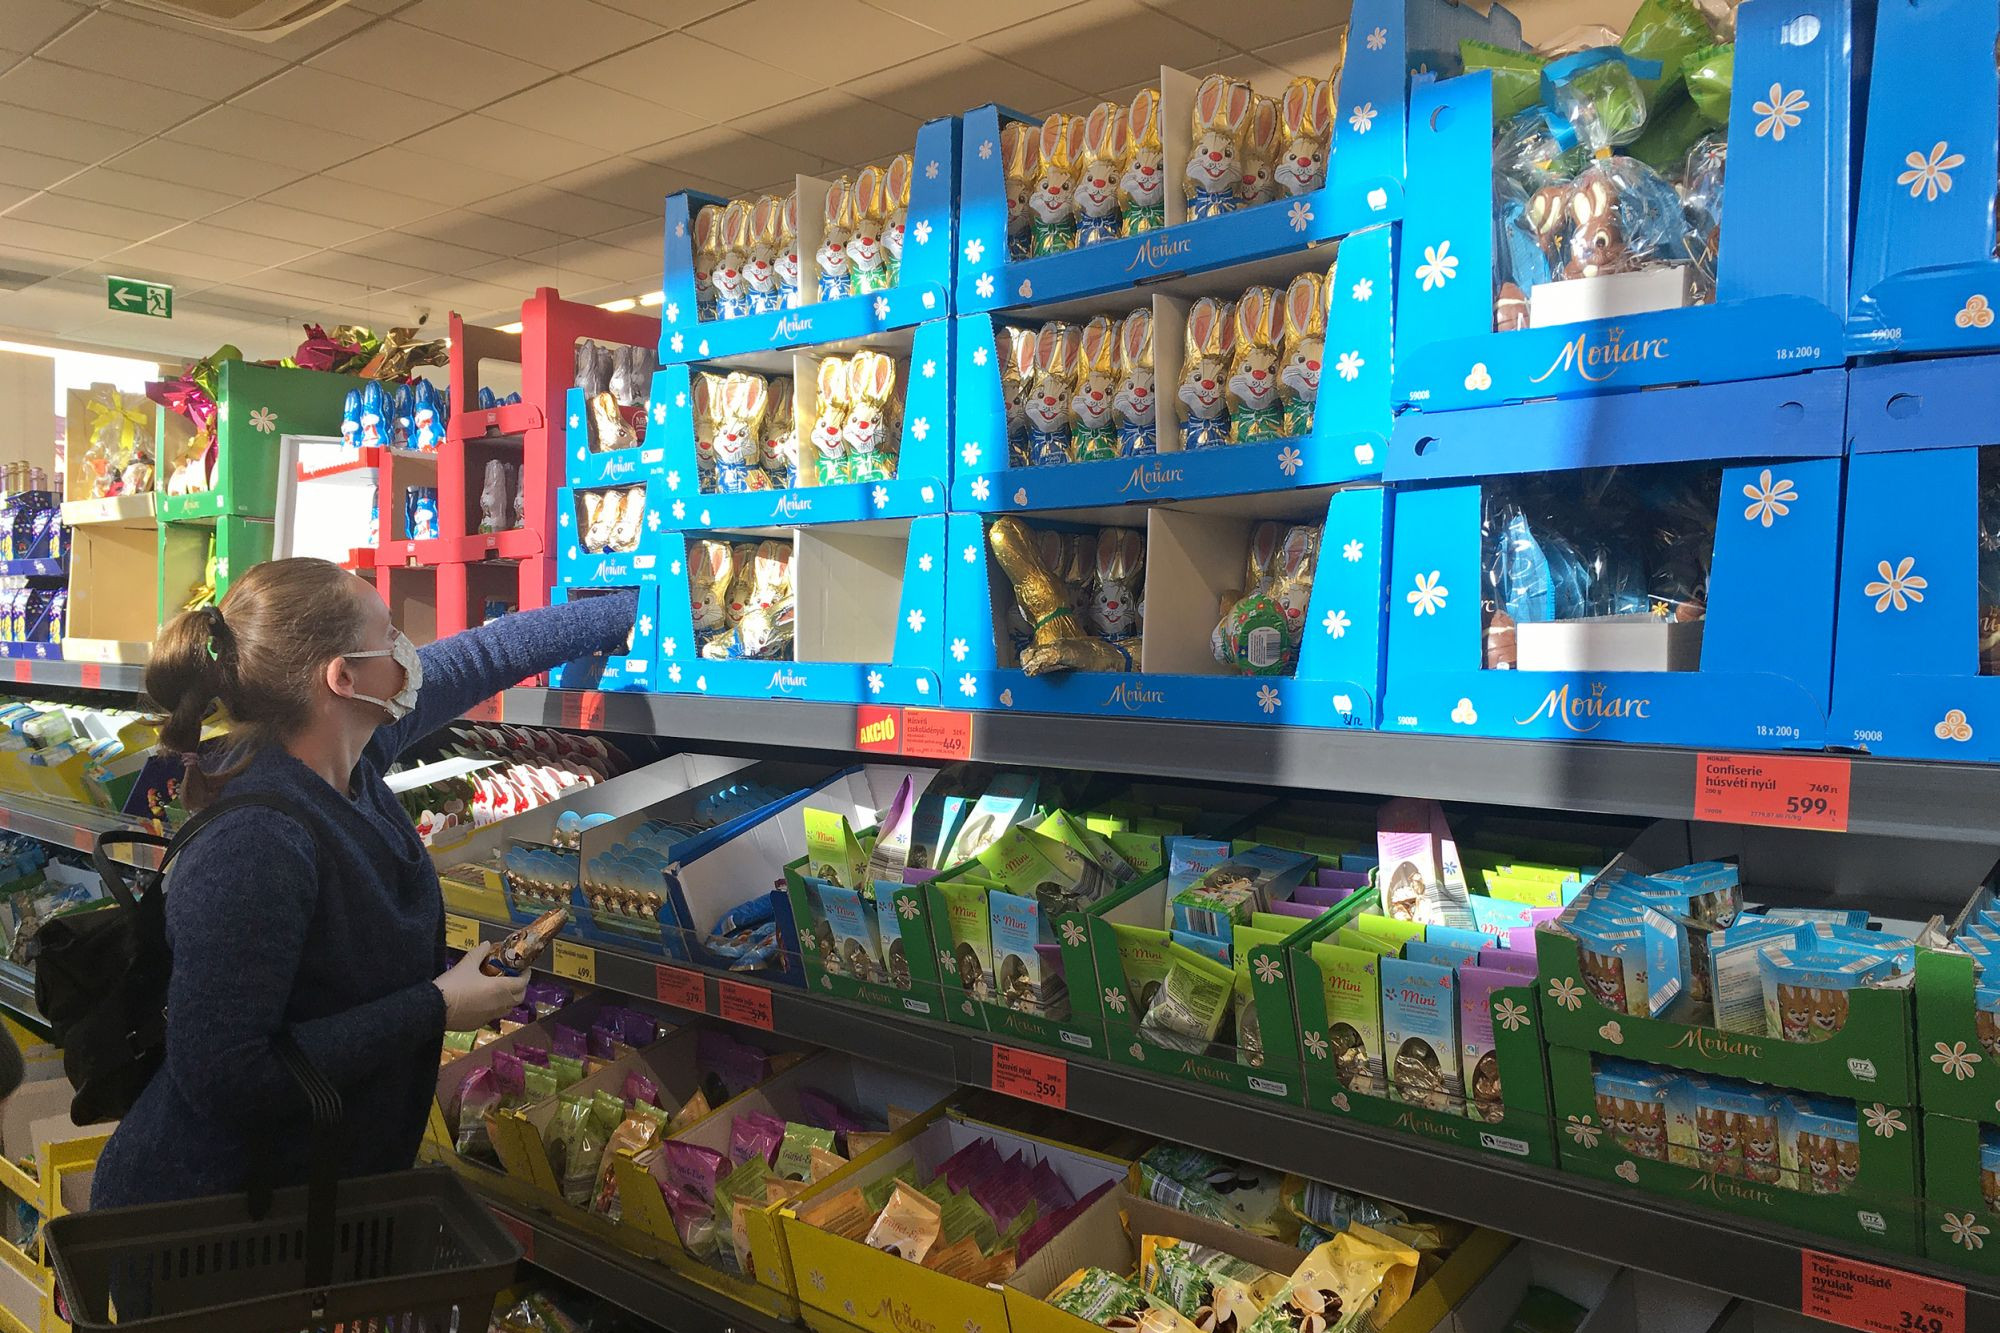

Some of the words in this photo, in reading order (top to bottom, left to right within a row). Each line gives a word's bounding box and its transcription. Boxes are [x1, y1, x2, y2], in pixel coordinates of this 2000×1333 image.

[1125, 238, 1192, 272] Monarc
[1871, 327, 1902, 341] 59008
[1529, 333, 1670, 383] Monarc
[1776, 348, 1787, 360] 18
[1795, 346, 1812, 358] 200
[1813, 346, 1820, 359] g
[1118, 463, 1185, 493] Monarc
[1101, 682, 1166, 711] Monarc
[1513, 683, 1652, 732] Monarc
[860, 714, 895, 744] AKCIÓ
[1756, 725, 1767, 736] 18
[1775, 726, 1792, 737] 200
[1793, 728, 1800, 740] g
[1853, 729, 1883, 741] 59008
[943, 738, 961, 750] 449
[1706, 764, 1763, 776] Confiserie
[1705, 776, 1748, 788] húsvéti
[1750, 779, 1776, 791] nyúl
[1809, 783, 1829, 793] 749
[1787, 796, 1827, 815] 599
[816, 831, 836, 843] Mini
[1005, 853, 1030, 872] Mini
[953, 905, 977, 918] Mini
[1003, 915, 1027, 929] Mini
[1328, 975, 1362, 993] Mini
[1400, 989, 1437, 1007] Mini
[1664, 1027, 1764, 1060] Monarc
[1852, 1061, 1870, 1070] UTZ
[1036, 1081, 1056, 1097] 559
[1686, 1171, 1777, 1206] Monarc
[1811, 1276, 1854, 1294] nyulak
[1899, 1311, 1943, 1333] 349
